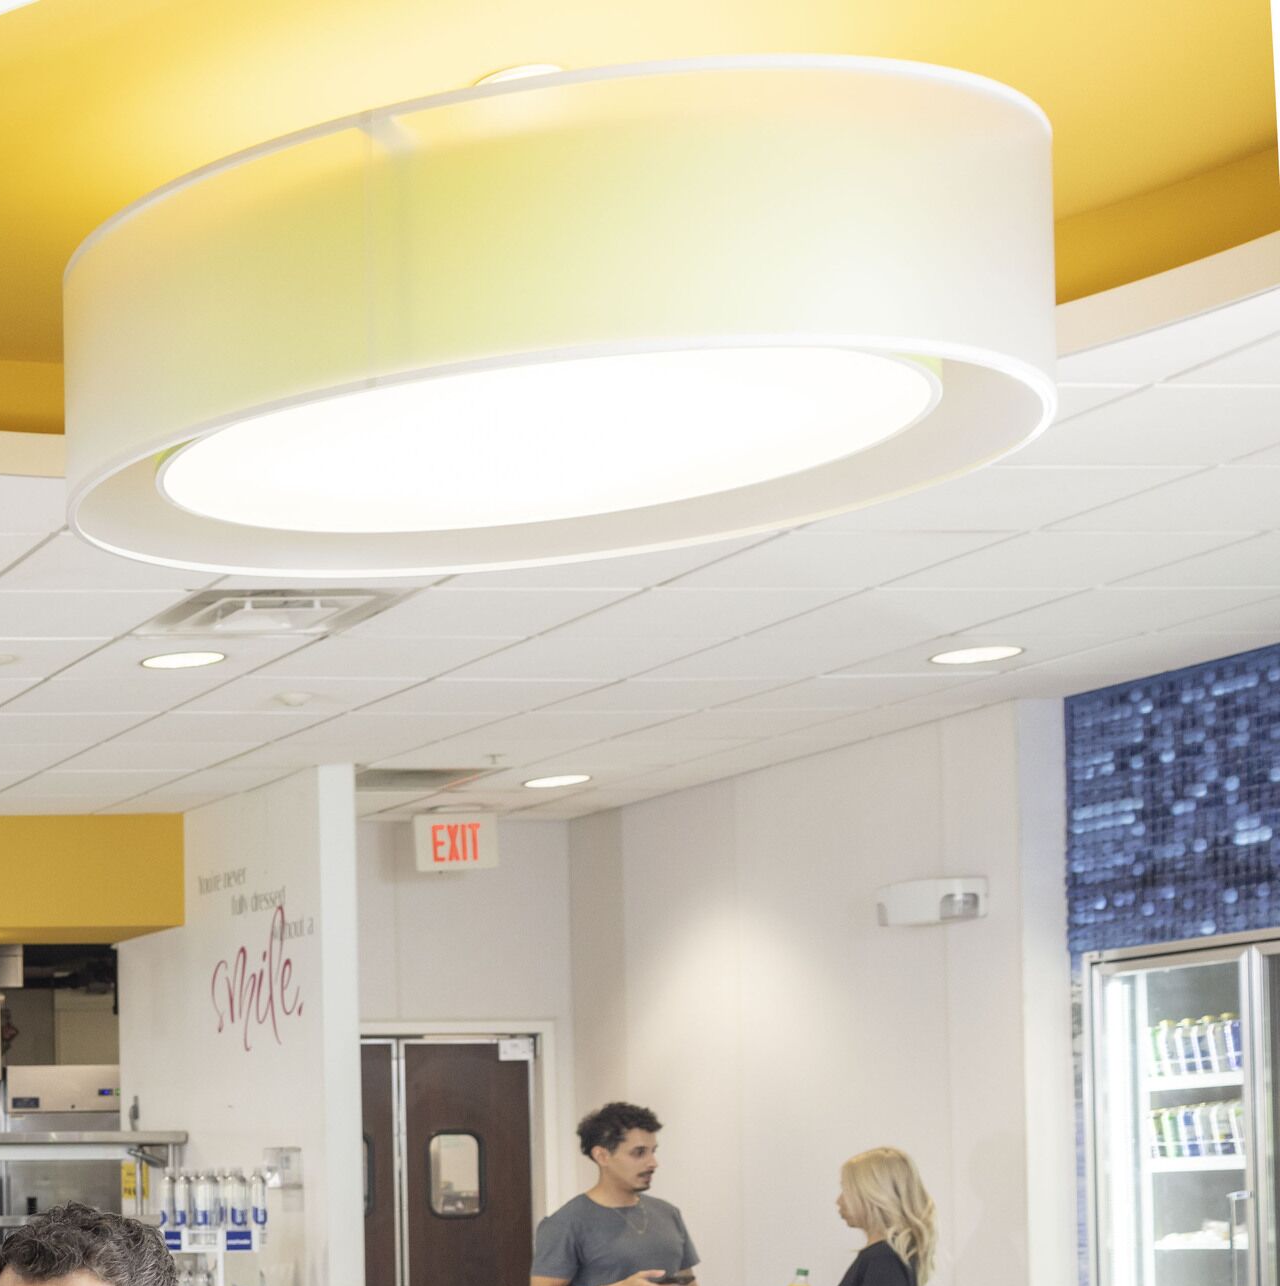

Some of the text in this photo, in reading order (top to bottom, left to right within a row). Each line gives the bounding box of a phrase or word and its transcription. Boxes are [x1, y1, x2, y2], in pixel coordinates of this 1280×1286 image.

[431, 823, 481, 863] EXIT
[223, 866, 246, 890] never
[251, 886, 286, 913] dressed
[307, 917, 315, 936] a
